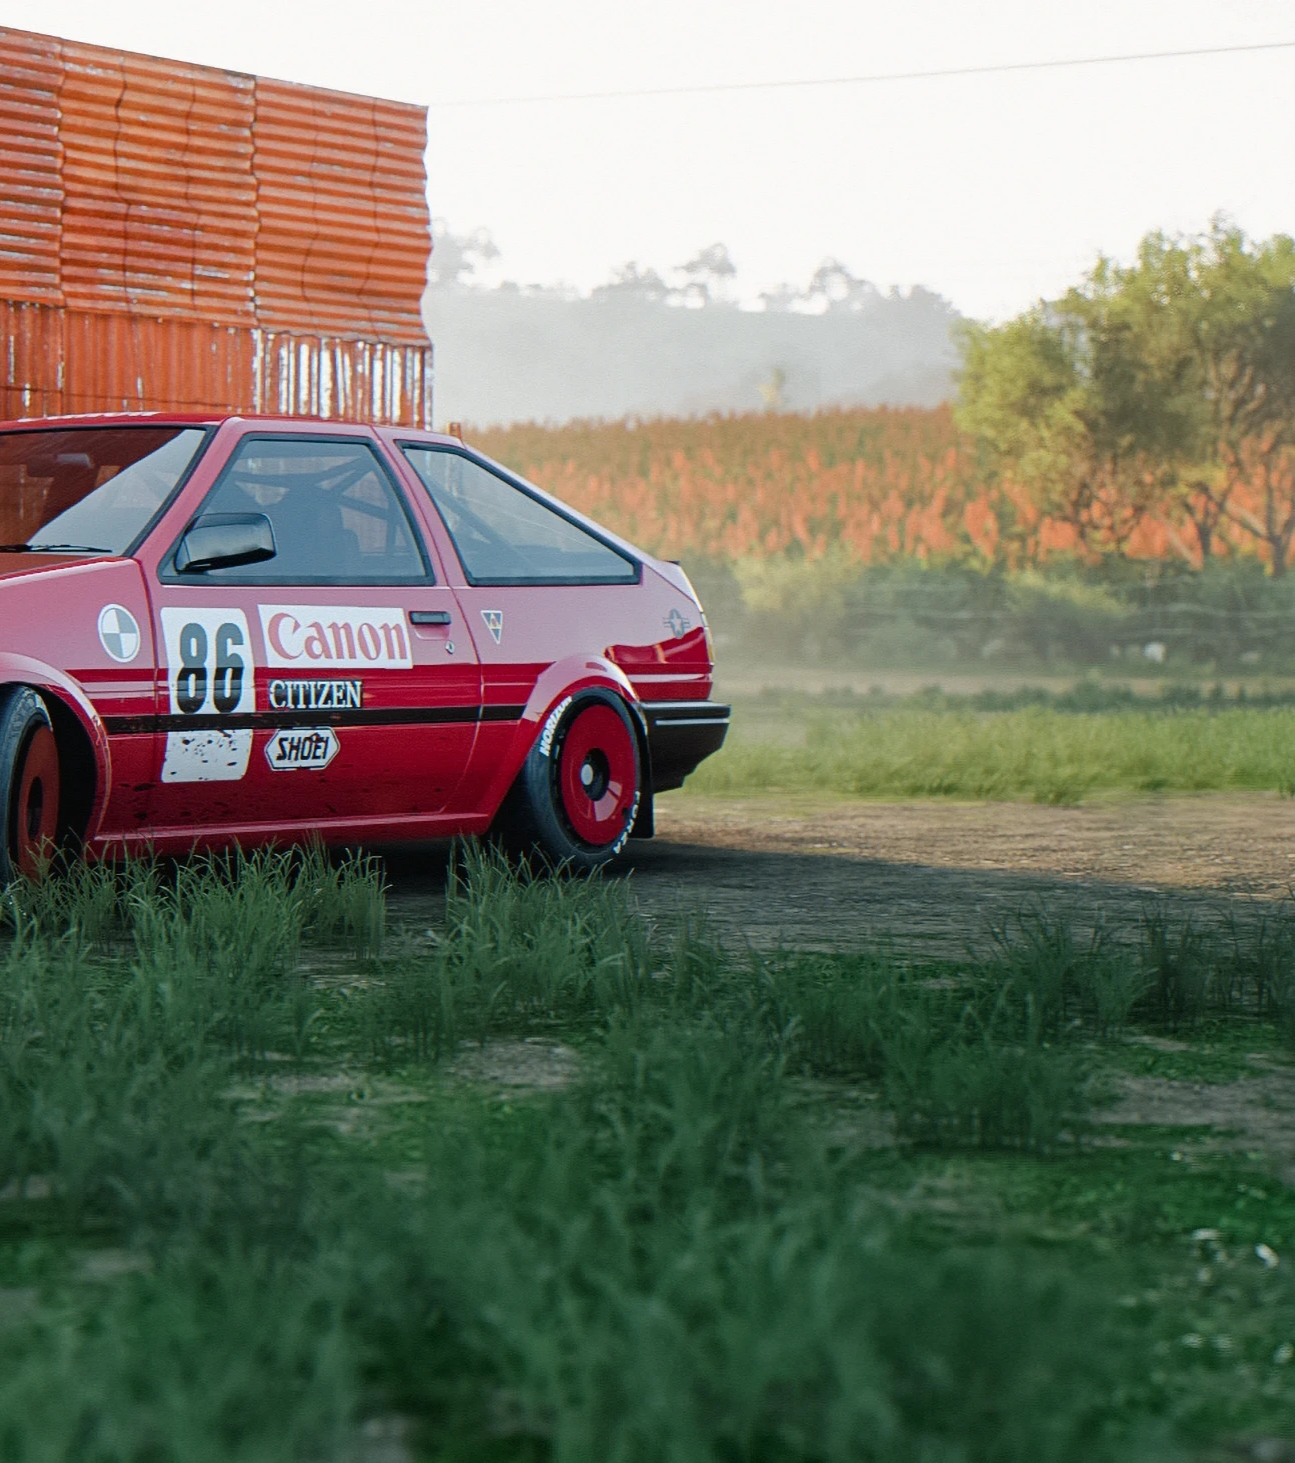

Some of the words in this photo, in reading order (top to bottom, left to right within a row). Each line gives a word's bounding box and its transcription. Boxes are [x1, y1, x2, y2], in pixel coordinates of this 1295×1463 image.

[267, 612, 407, 660] Canon
[177, 622, 244, 714] 86
[269, 680, 363, 709] CITIZEN
[276, 736, 329, 761] SHOEI
